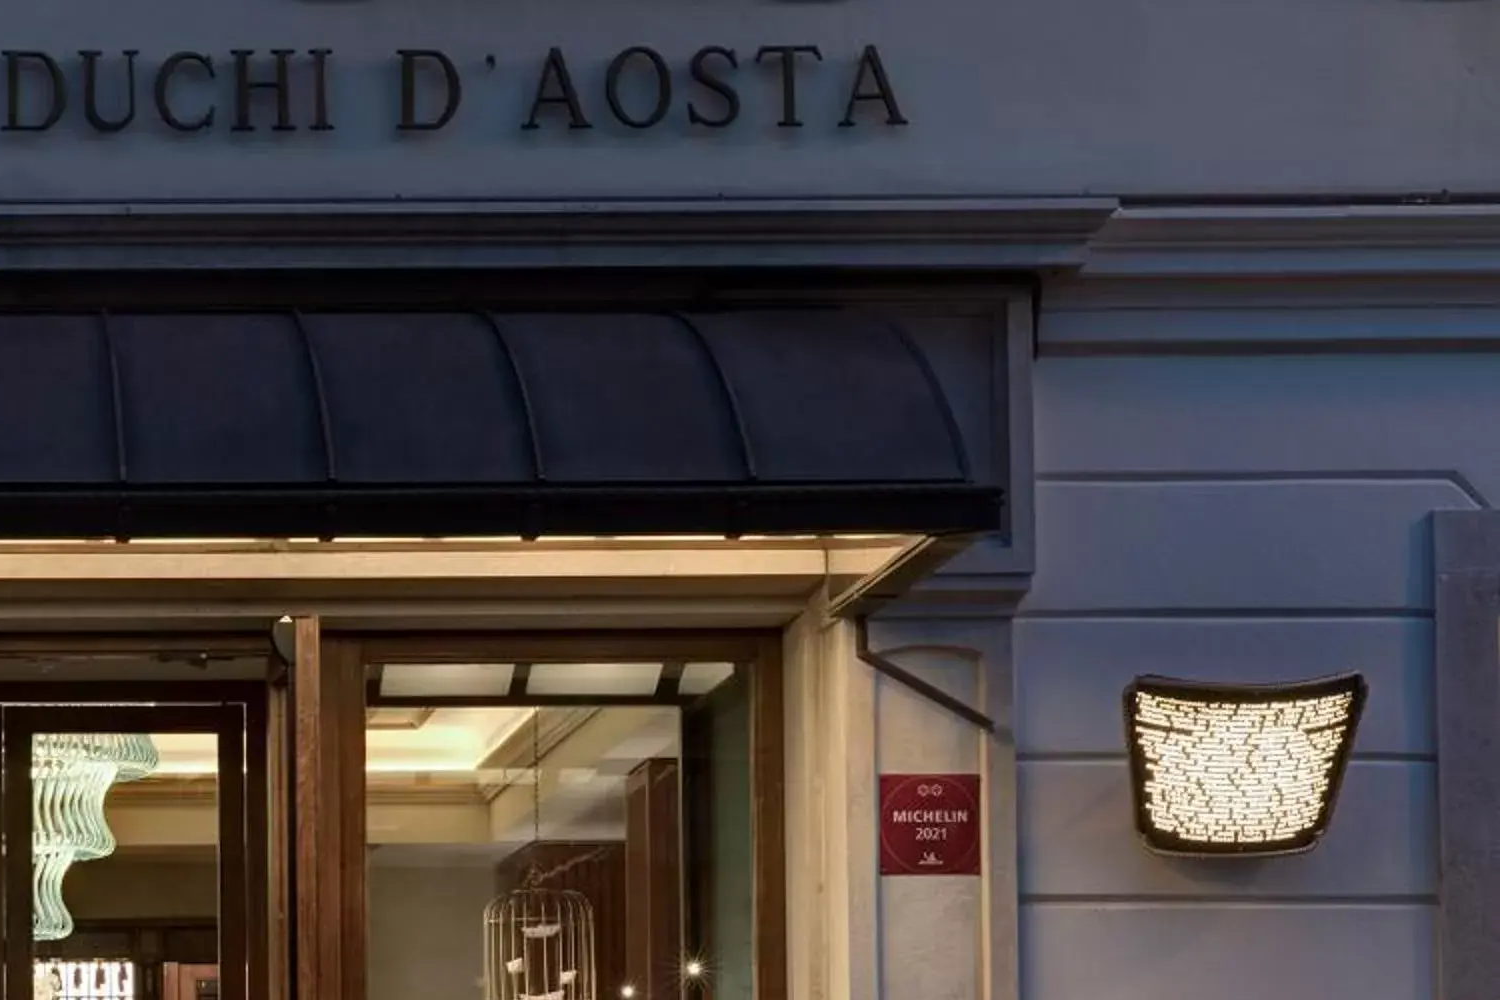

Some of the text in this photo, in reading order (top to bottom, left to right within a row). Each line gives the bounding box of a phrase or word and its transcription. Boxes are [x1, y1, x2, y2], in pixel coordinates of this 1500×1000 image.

[0, 48, 336, 134] DUCHI
[396, 44, 910, 132] D'AOSTA
[892, 809, 968, 823] MICHELIN
[915, 827, 948, 841] 2021
